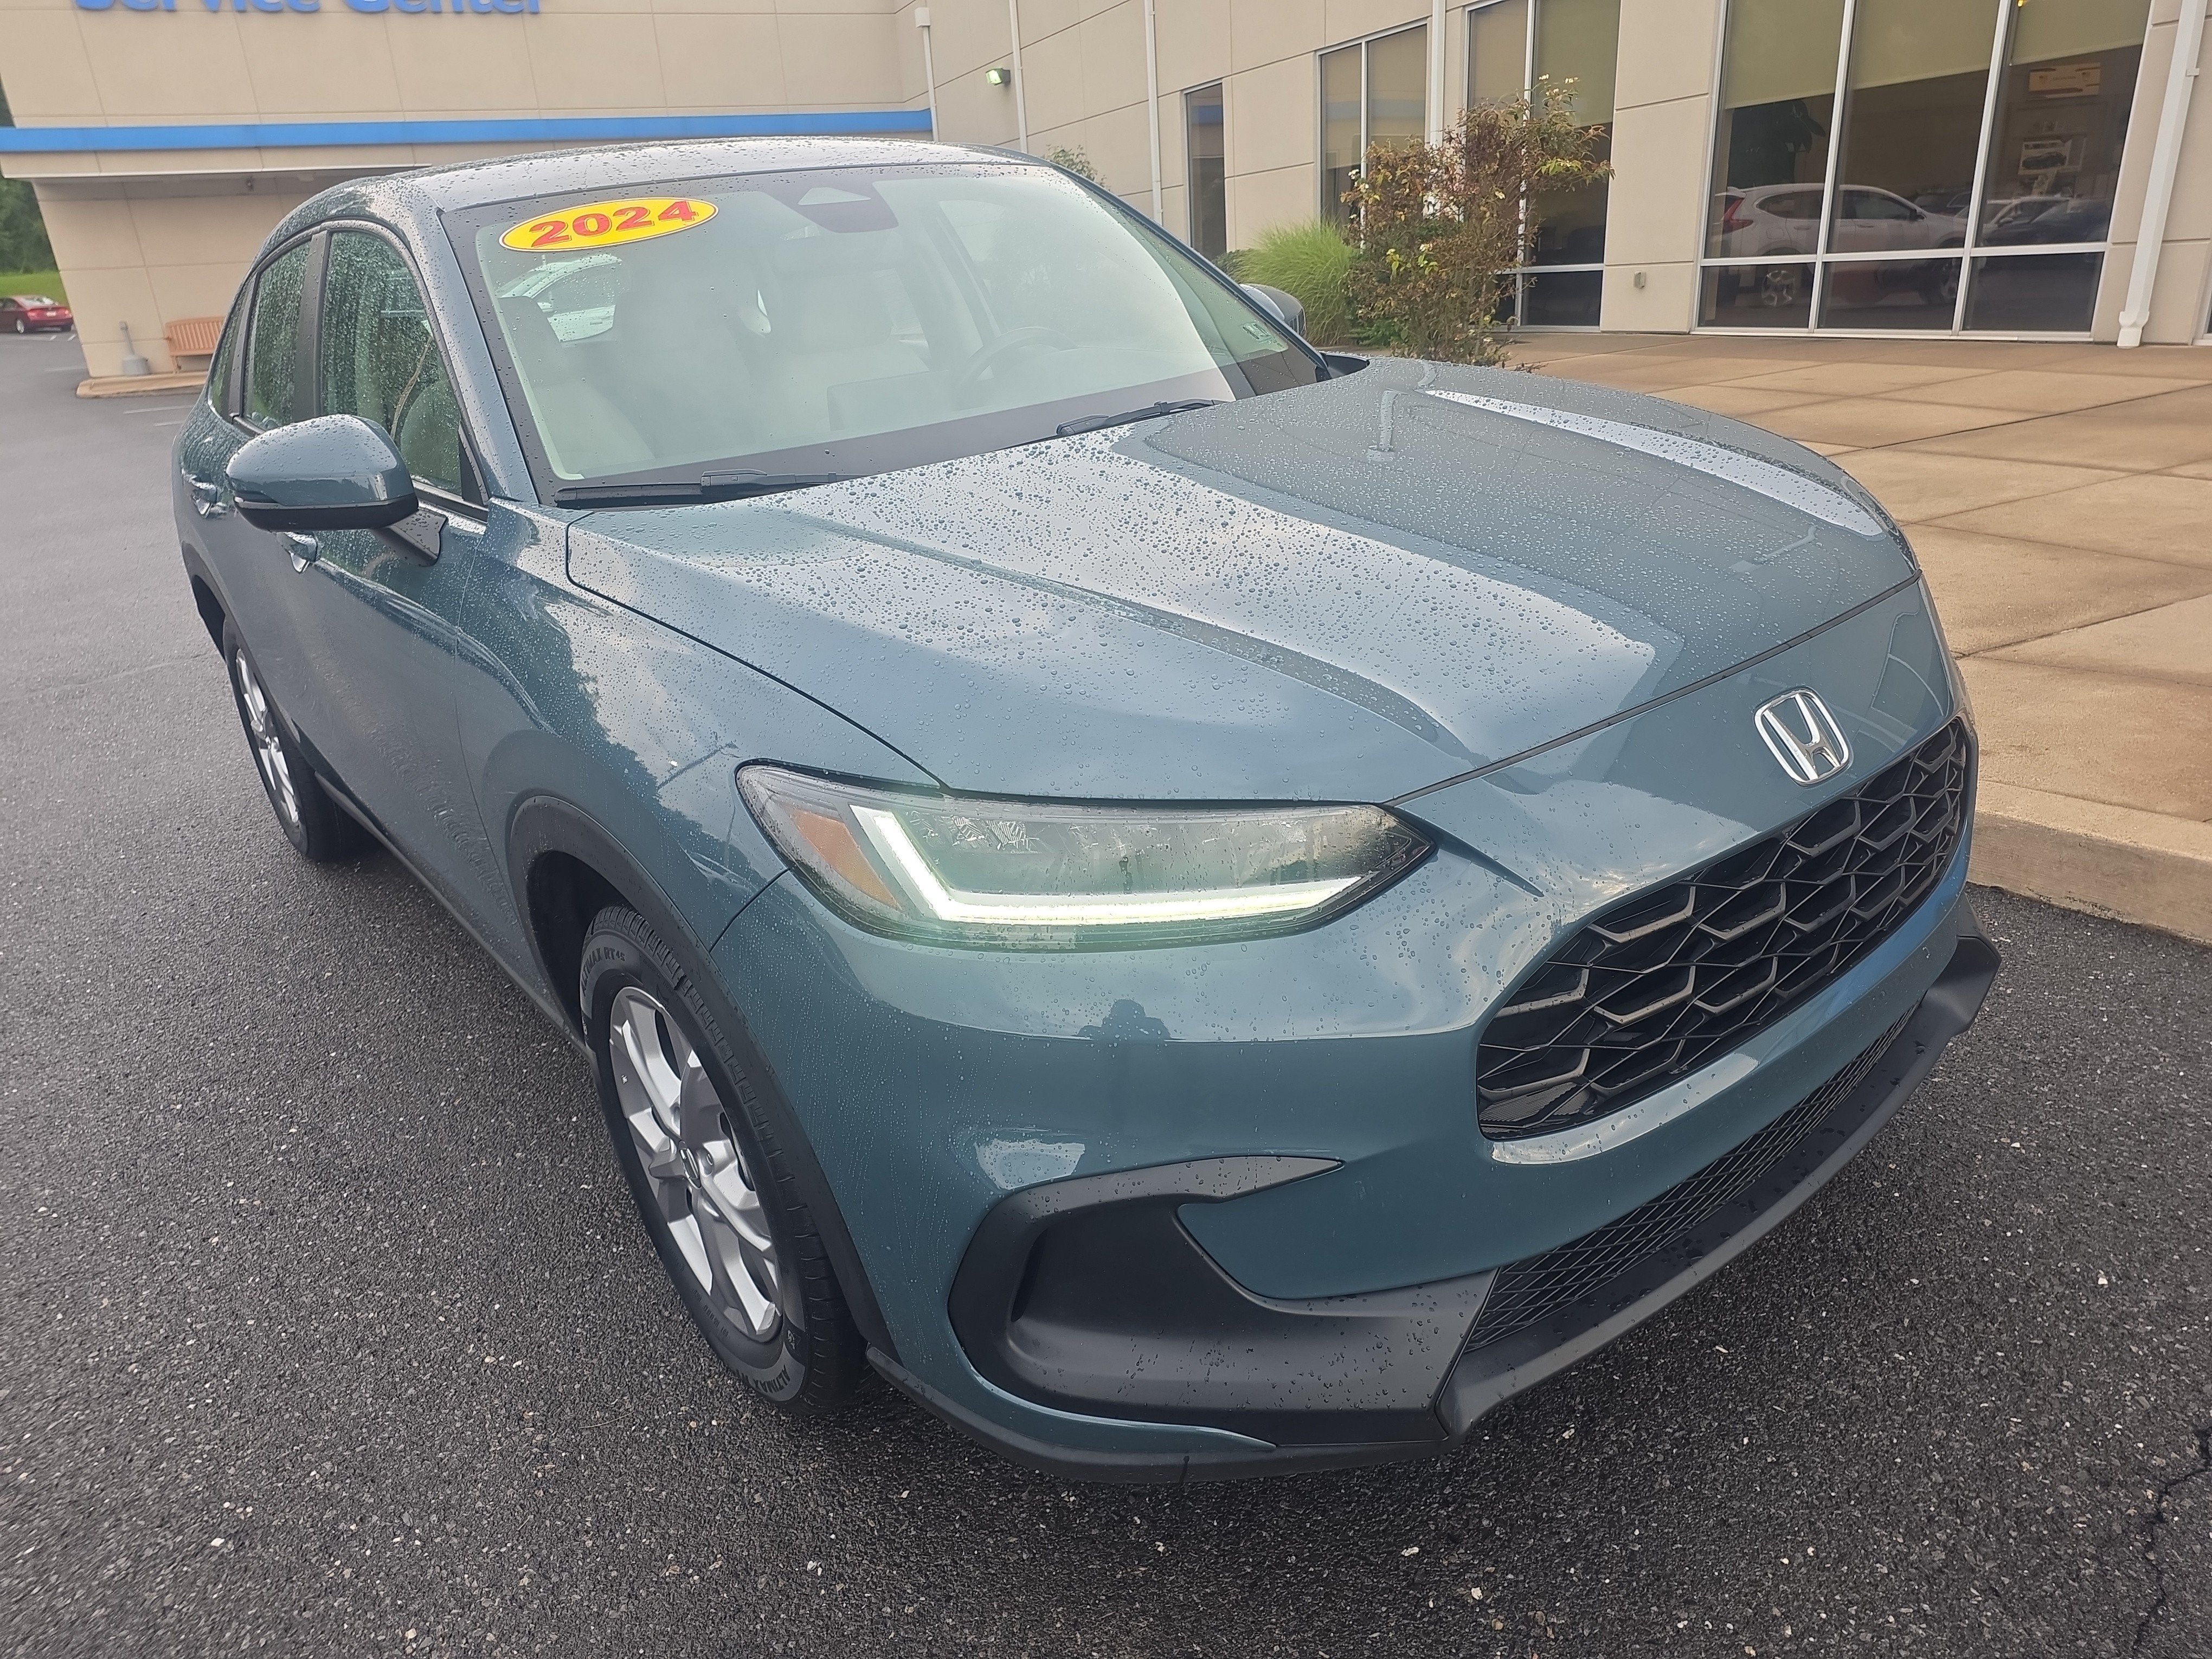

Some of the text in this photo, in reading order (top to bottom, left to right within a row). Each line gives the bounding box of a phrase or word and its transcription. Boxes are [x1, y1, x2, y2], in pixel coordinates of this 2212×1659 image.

[529, 201, 698, 247] 2024
[581, 948, 601, 995] ALTIMAX
[754, 1365, 790, 1393] ALTIMAX
